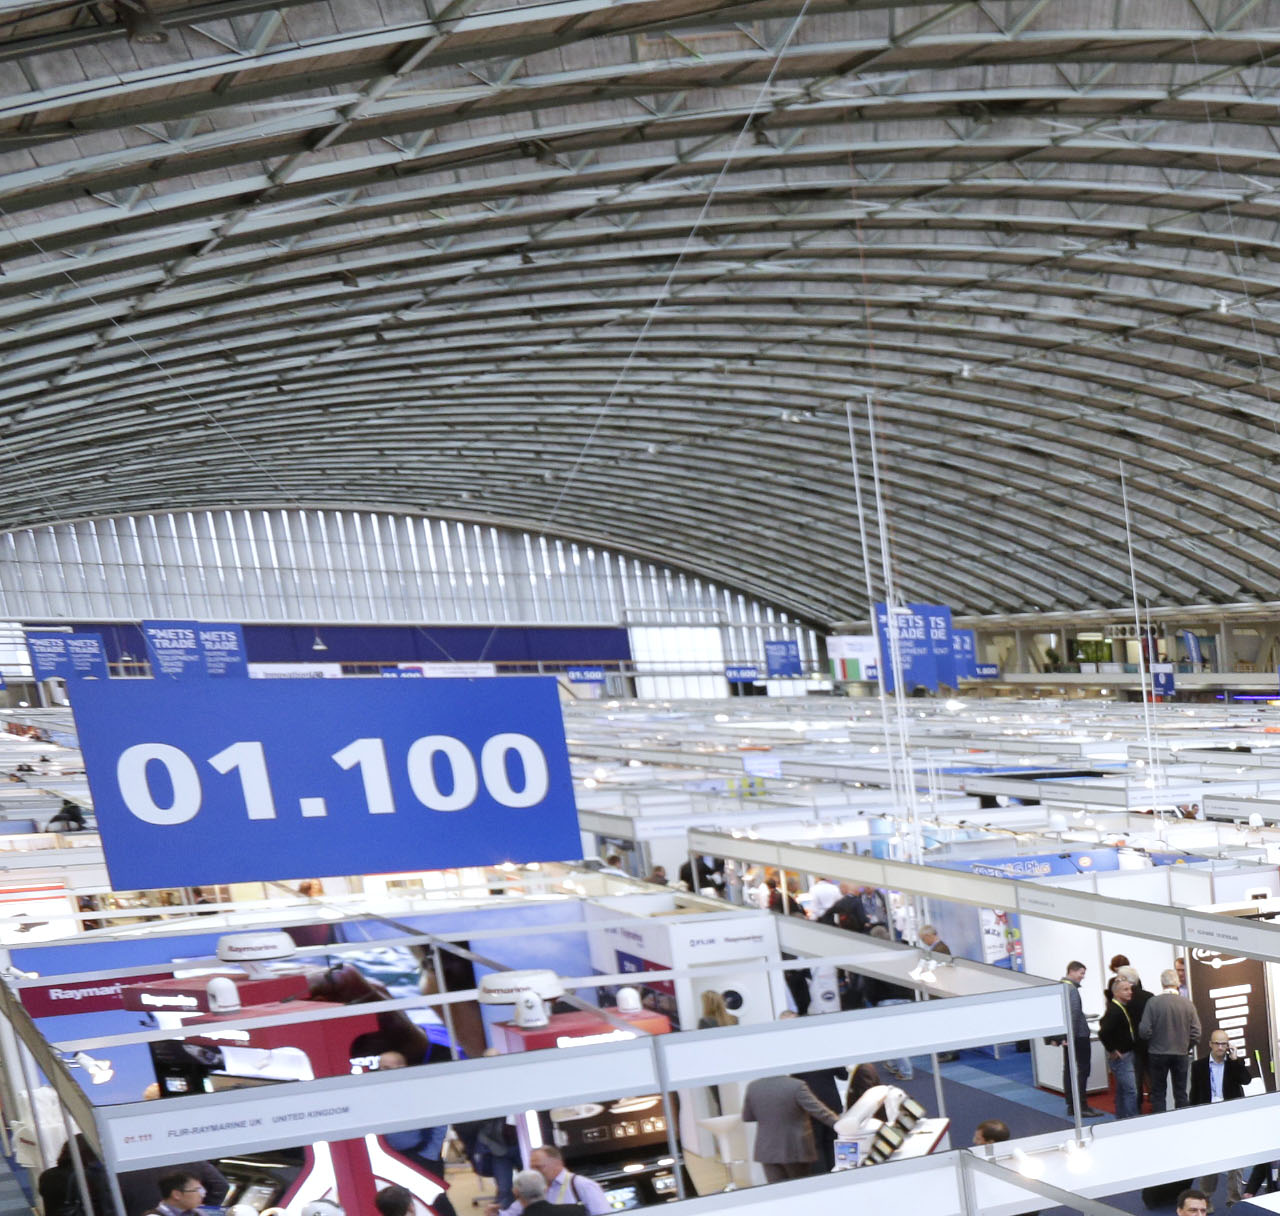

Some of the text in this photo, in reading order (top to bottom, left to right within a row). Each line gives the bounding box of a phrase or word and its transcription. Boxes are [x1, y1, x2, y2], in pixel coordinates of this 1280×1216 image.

[116, 733, 550, 826] 01.100
[272, 1112, 306, 1124] UNITED
[307, 1106, 350, 1118] KINGDOM
